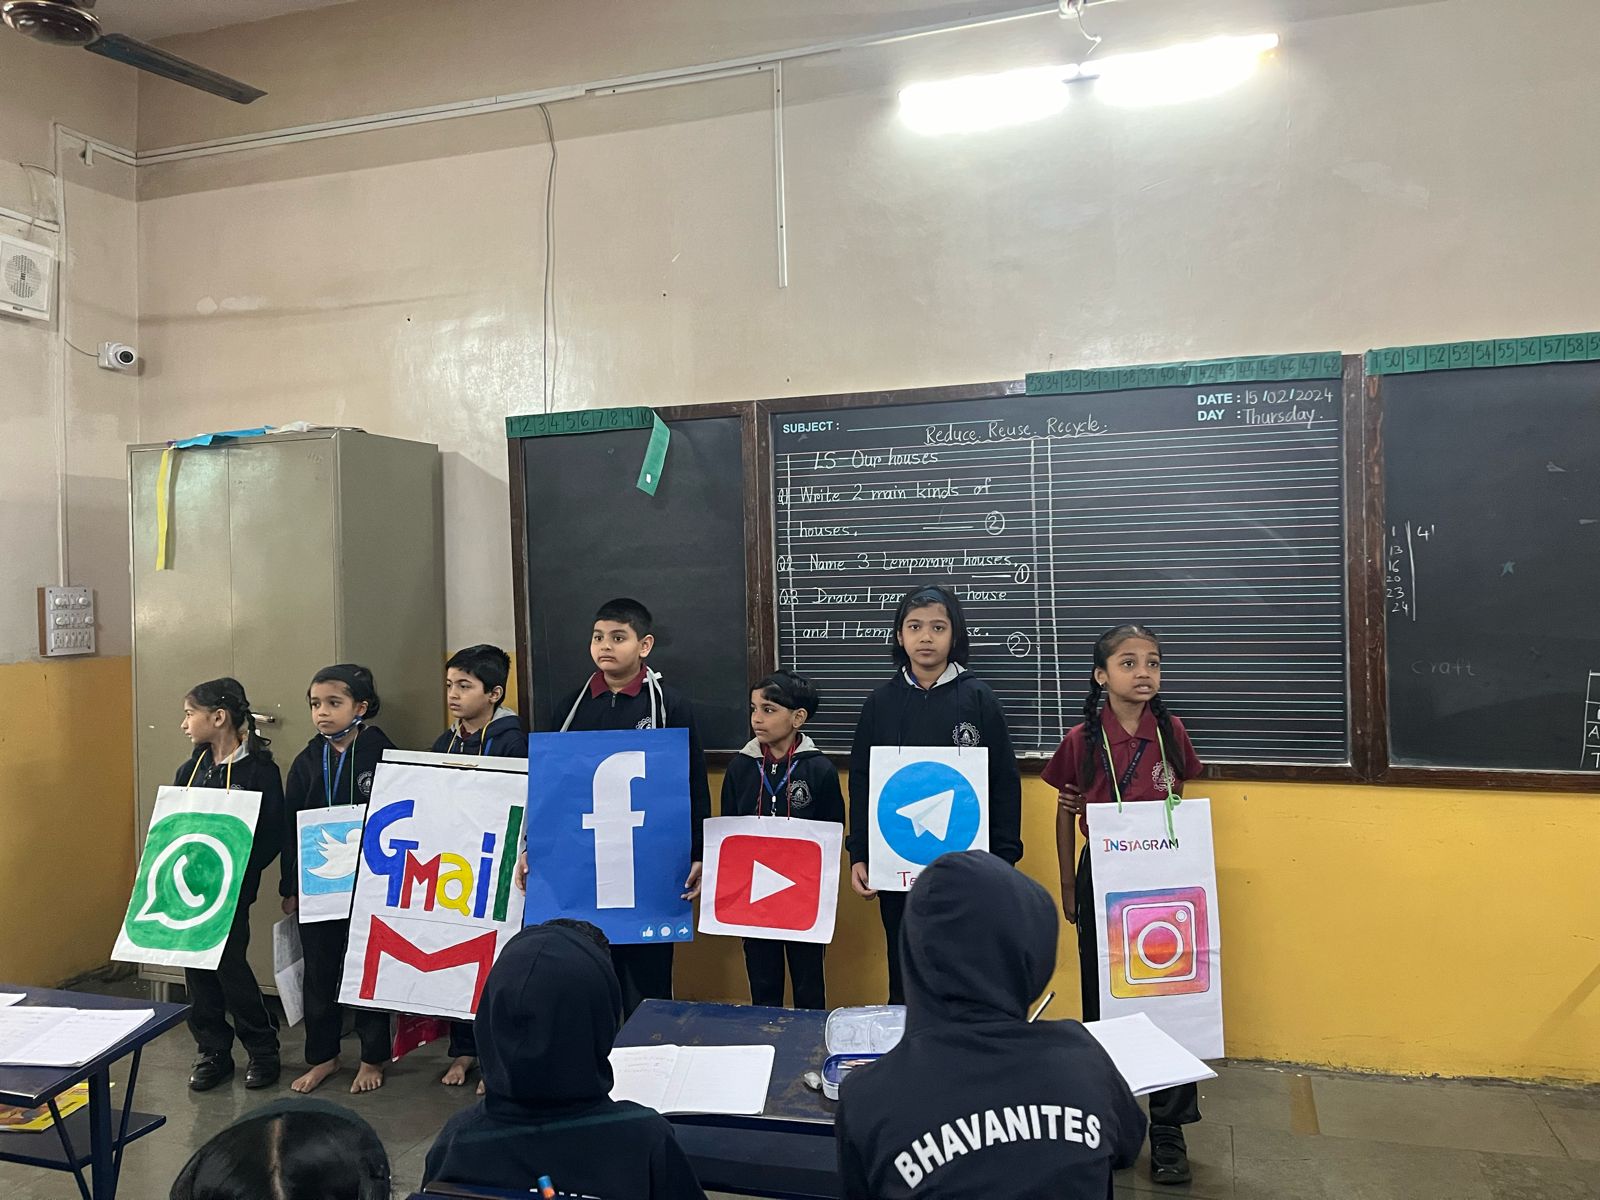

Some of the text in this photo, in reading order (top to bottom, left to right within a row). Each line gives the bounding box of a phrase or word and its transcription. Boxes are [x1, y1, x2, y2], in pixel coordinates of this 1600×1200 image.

[1384, 351, 1400, 367] 50
[1407, 349, 1419, 365] 51
[1428, 348, 1446, 363] 52
[1452, 347, 1470, 362] 53
[1475, 344, 1491, 360] 54
[1498, 343, 1514, 359] 55
[1520, 341, 1536, 356] 56
[1544, 338, 1562, 354] 57
[1568, 337, 1583, 353] 58
[1591, 336, 1600, 351] 5
[521, 418, 532, 432] 2
[550, 416, 559, 430] 4
[566, 414, 576, 429] 5
[581, 412, 589, 427] 6
[595, 412, 603, 427] 7
[611, 410, 618, 426] 8
[626, 410, 633, 425] 9
[852, 450, 882, 468] Our
[888, 448, 938, 465] houses
[800, 486, 840, 503] Write
[852, 484, 862, 500] 2
[871, 485, 906, 500] main
[916, 478, 959, 498] kinds
[974, 478, 992, 496] of
[1390, 545, 1403, 556] 13
[810, 553, 846, 571] Name
[857, 553, 870, 569] 3
[883, 552, 954, 574] temporary
[1388, 560, 1400, 572] 16
[812, 587, 857, 604] Draw
[967, 584, 1007, 600] house
[1386, 587, 1405, 599] 23
[1391, 601, 1408, 616] 24
[803, 620, 829, 639] and
[894, 1105, 1101, 1189] BHAVANITES
